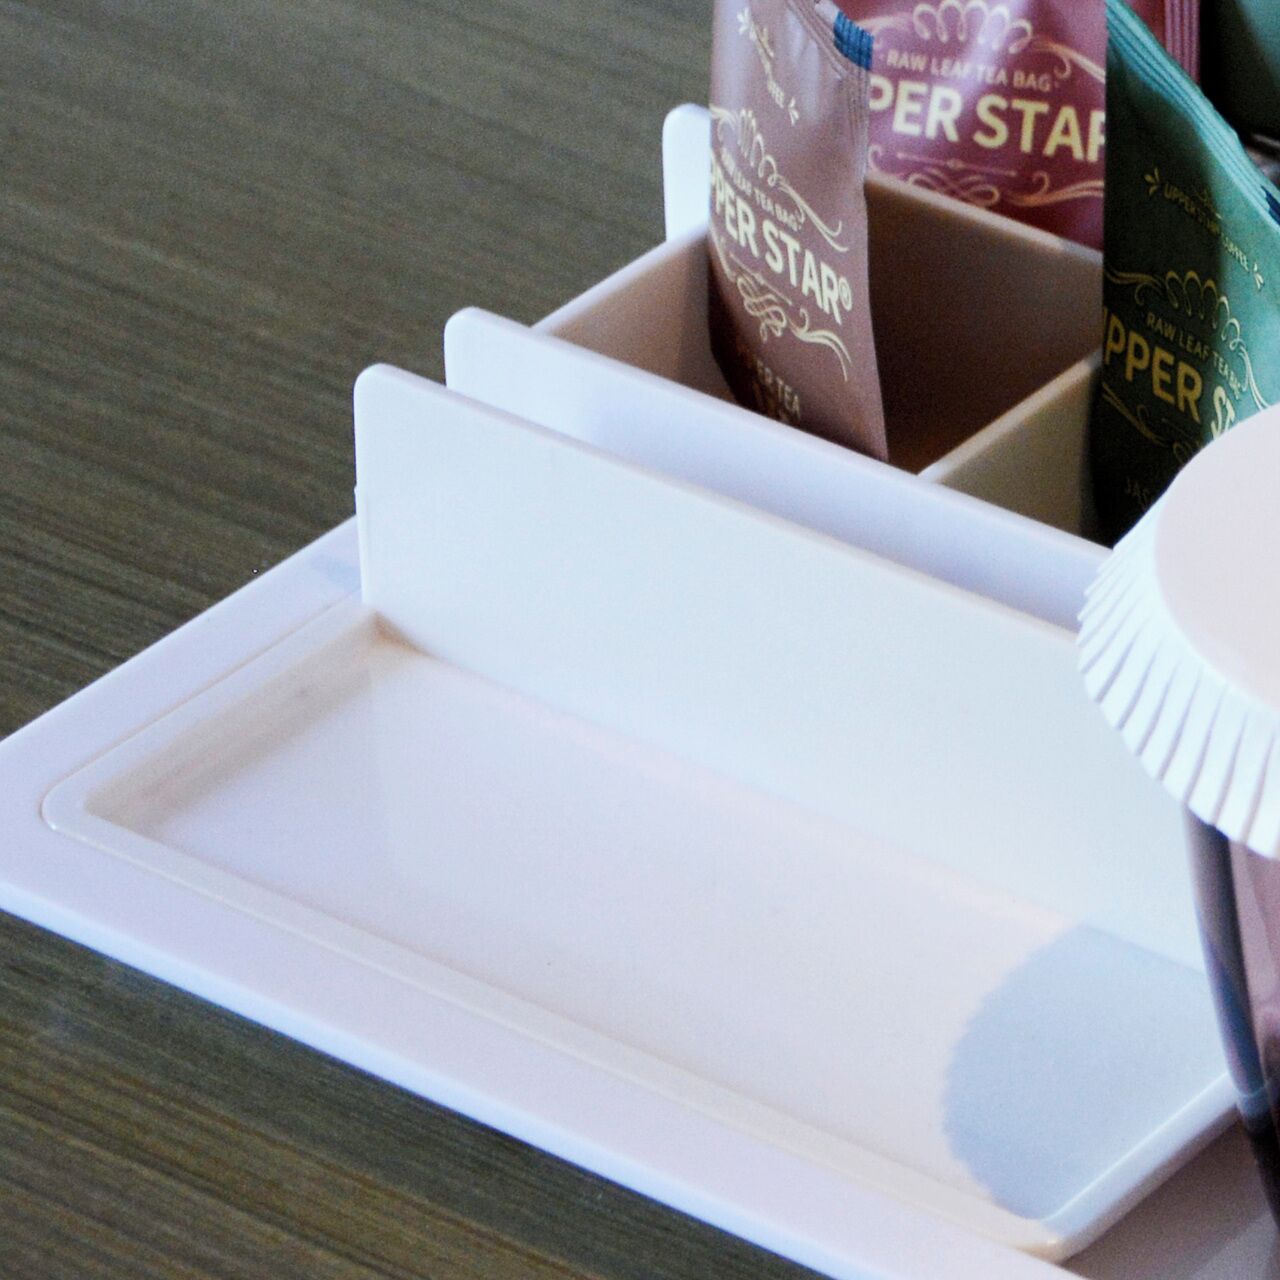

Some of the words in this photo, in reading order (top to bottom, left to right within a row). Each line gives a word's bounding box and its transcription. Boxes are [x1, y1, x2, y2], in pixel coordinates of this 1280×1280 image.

[886, 49, 928, 72] RAW
[975, 65, 1008, 85] TEA
[1012, 71, 1050, 93] BAG
[762, 219, 853, 325] STAR®
[1102, 305, 1204, 425] PPER
[1146, 312, 1176, 342] RAW
[1179, 330, 1210, 360] LEAF
